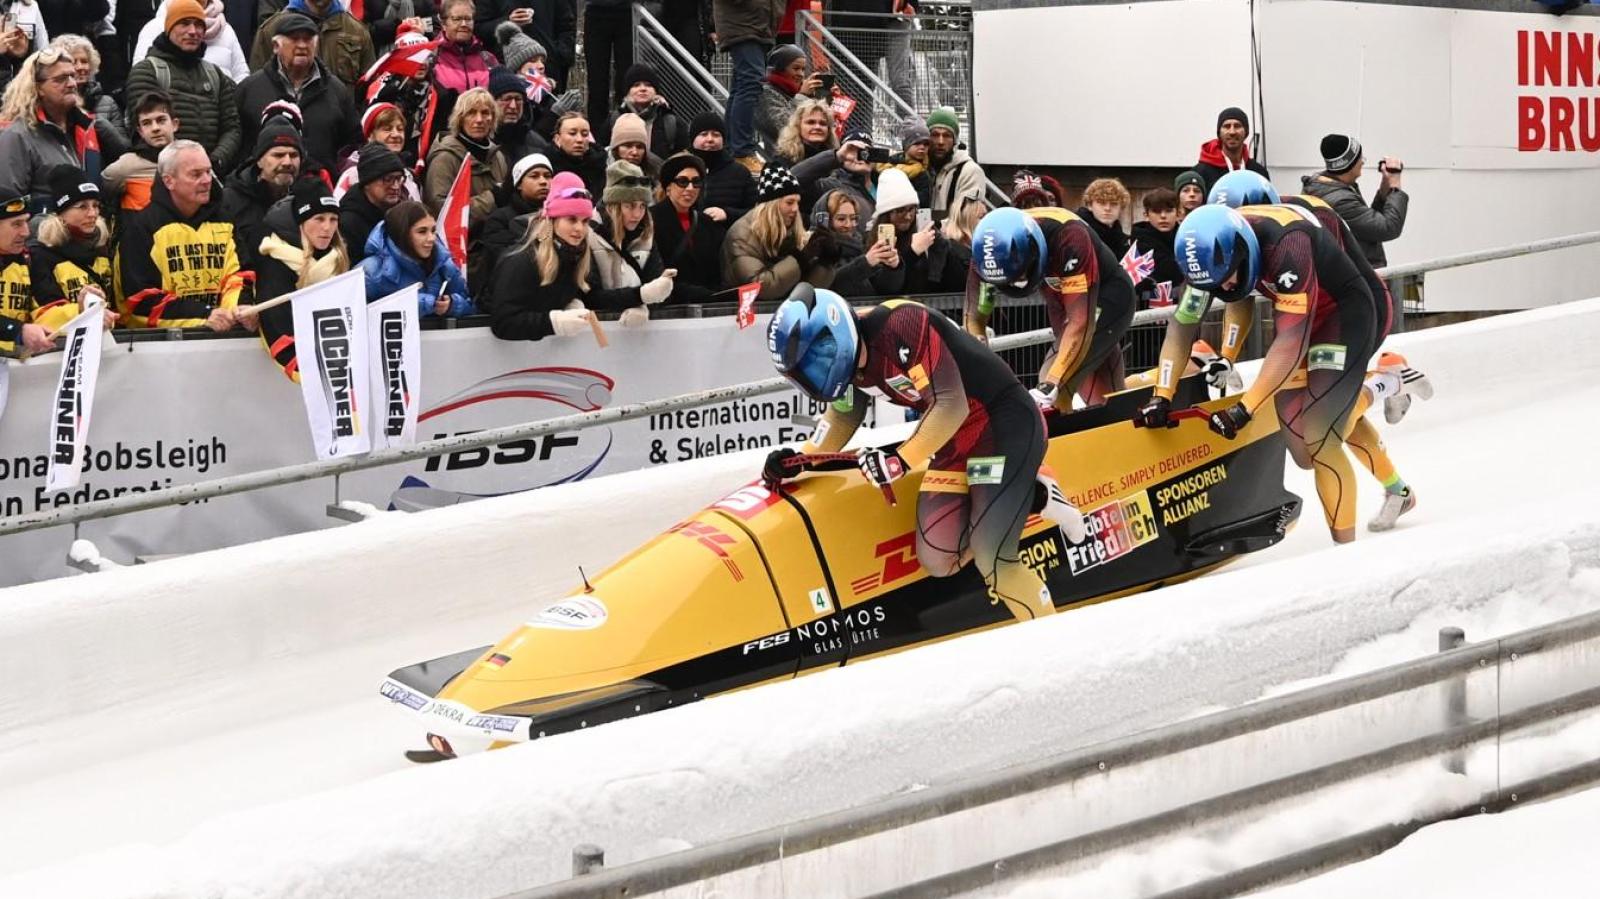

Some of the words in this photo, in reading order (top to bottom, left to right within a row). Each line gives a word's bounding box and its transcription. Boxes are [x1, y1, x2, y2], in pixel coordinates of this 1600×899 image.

[1518, 30, 1600, 87] INN
[983, 234, 997, 270] BMW
[1184, 237, 1201, 272] BMW
[312, 308, 353, 438] LOCHNER
[381, 311, 406, 437] LOCHNER
[649, 394, 798, 431] International
[81, 436, 227, 473] Bobsleigh
[425, 428, 582, 472] IBSF
[648, 439, 667, 464] &
[678, 432, 772, 463] Skeleton
[1068, 482, 1118, 508] ELLENCE.
[1119, 464, 1156, 491] SIMPLY
[1159, 443, 1213, 475] DELIVERED.
[1156, 464, 1227, 507] SPONSOREN
[1162, 491, 1211, 527] ALLIANZ
[816, 591, 826, 608] 4
[742, 632, 791, 656] FES
[797, 606, 885, 641] NOMOS
[814, 627, 880, 654] GLASÜTTE
[433, 704, 465, 723] DEKRA
